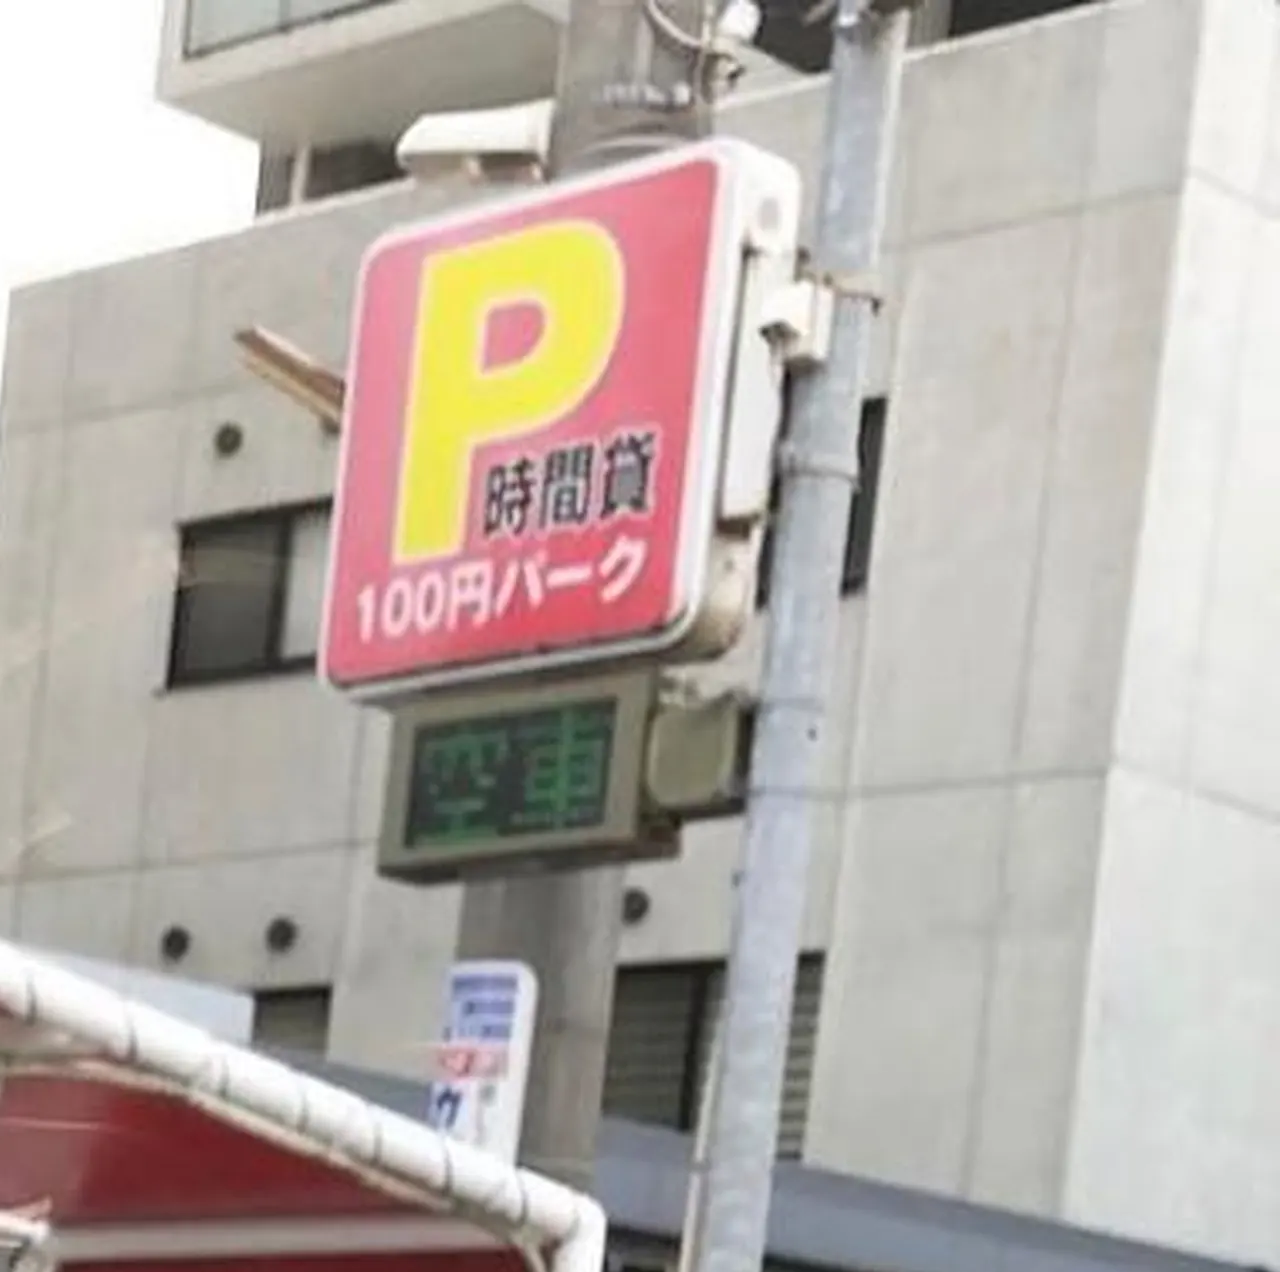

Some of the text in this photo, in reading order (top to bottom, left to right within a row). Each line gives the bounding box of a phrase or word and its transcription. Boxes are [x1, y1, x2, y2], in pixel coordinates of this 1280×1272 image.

[393, 218, 626, 565] P
[482, 431, 654, 537] 時間貸
[357, 534, 648, 643] 100円パーク
[413, 706, 608, 846] 空車
